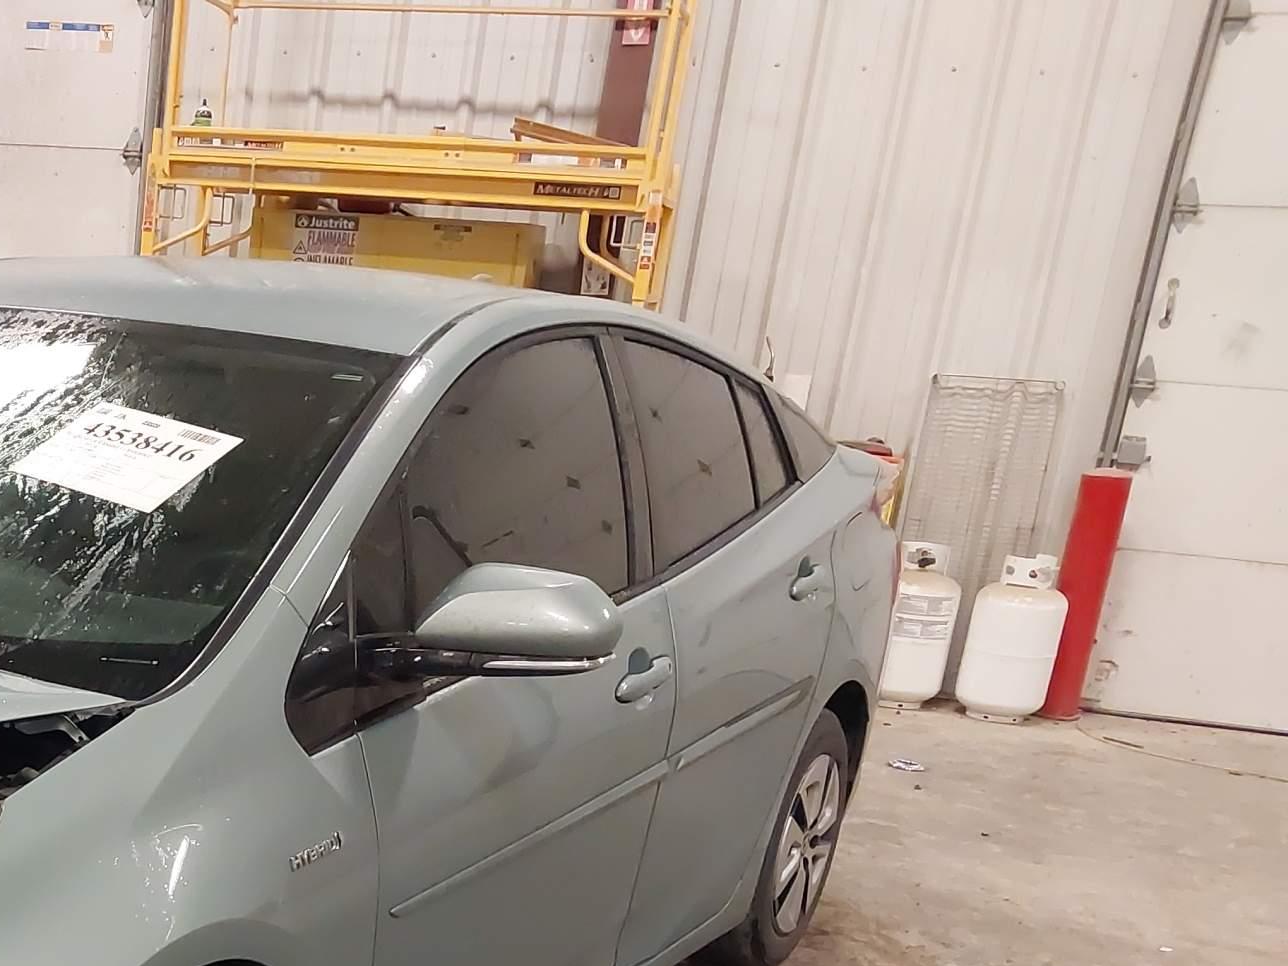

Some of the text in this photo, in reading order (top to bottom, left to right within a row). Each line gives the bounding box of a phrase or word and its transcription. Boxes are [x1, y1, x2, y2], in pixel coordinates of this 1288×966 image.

[310, 215, 356, 229] Justrite
[84, 422, 202, 463] 43538416
[288, 831, 342, 873] HYBRID
